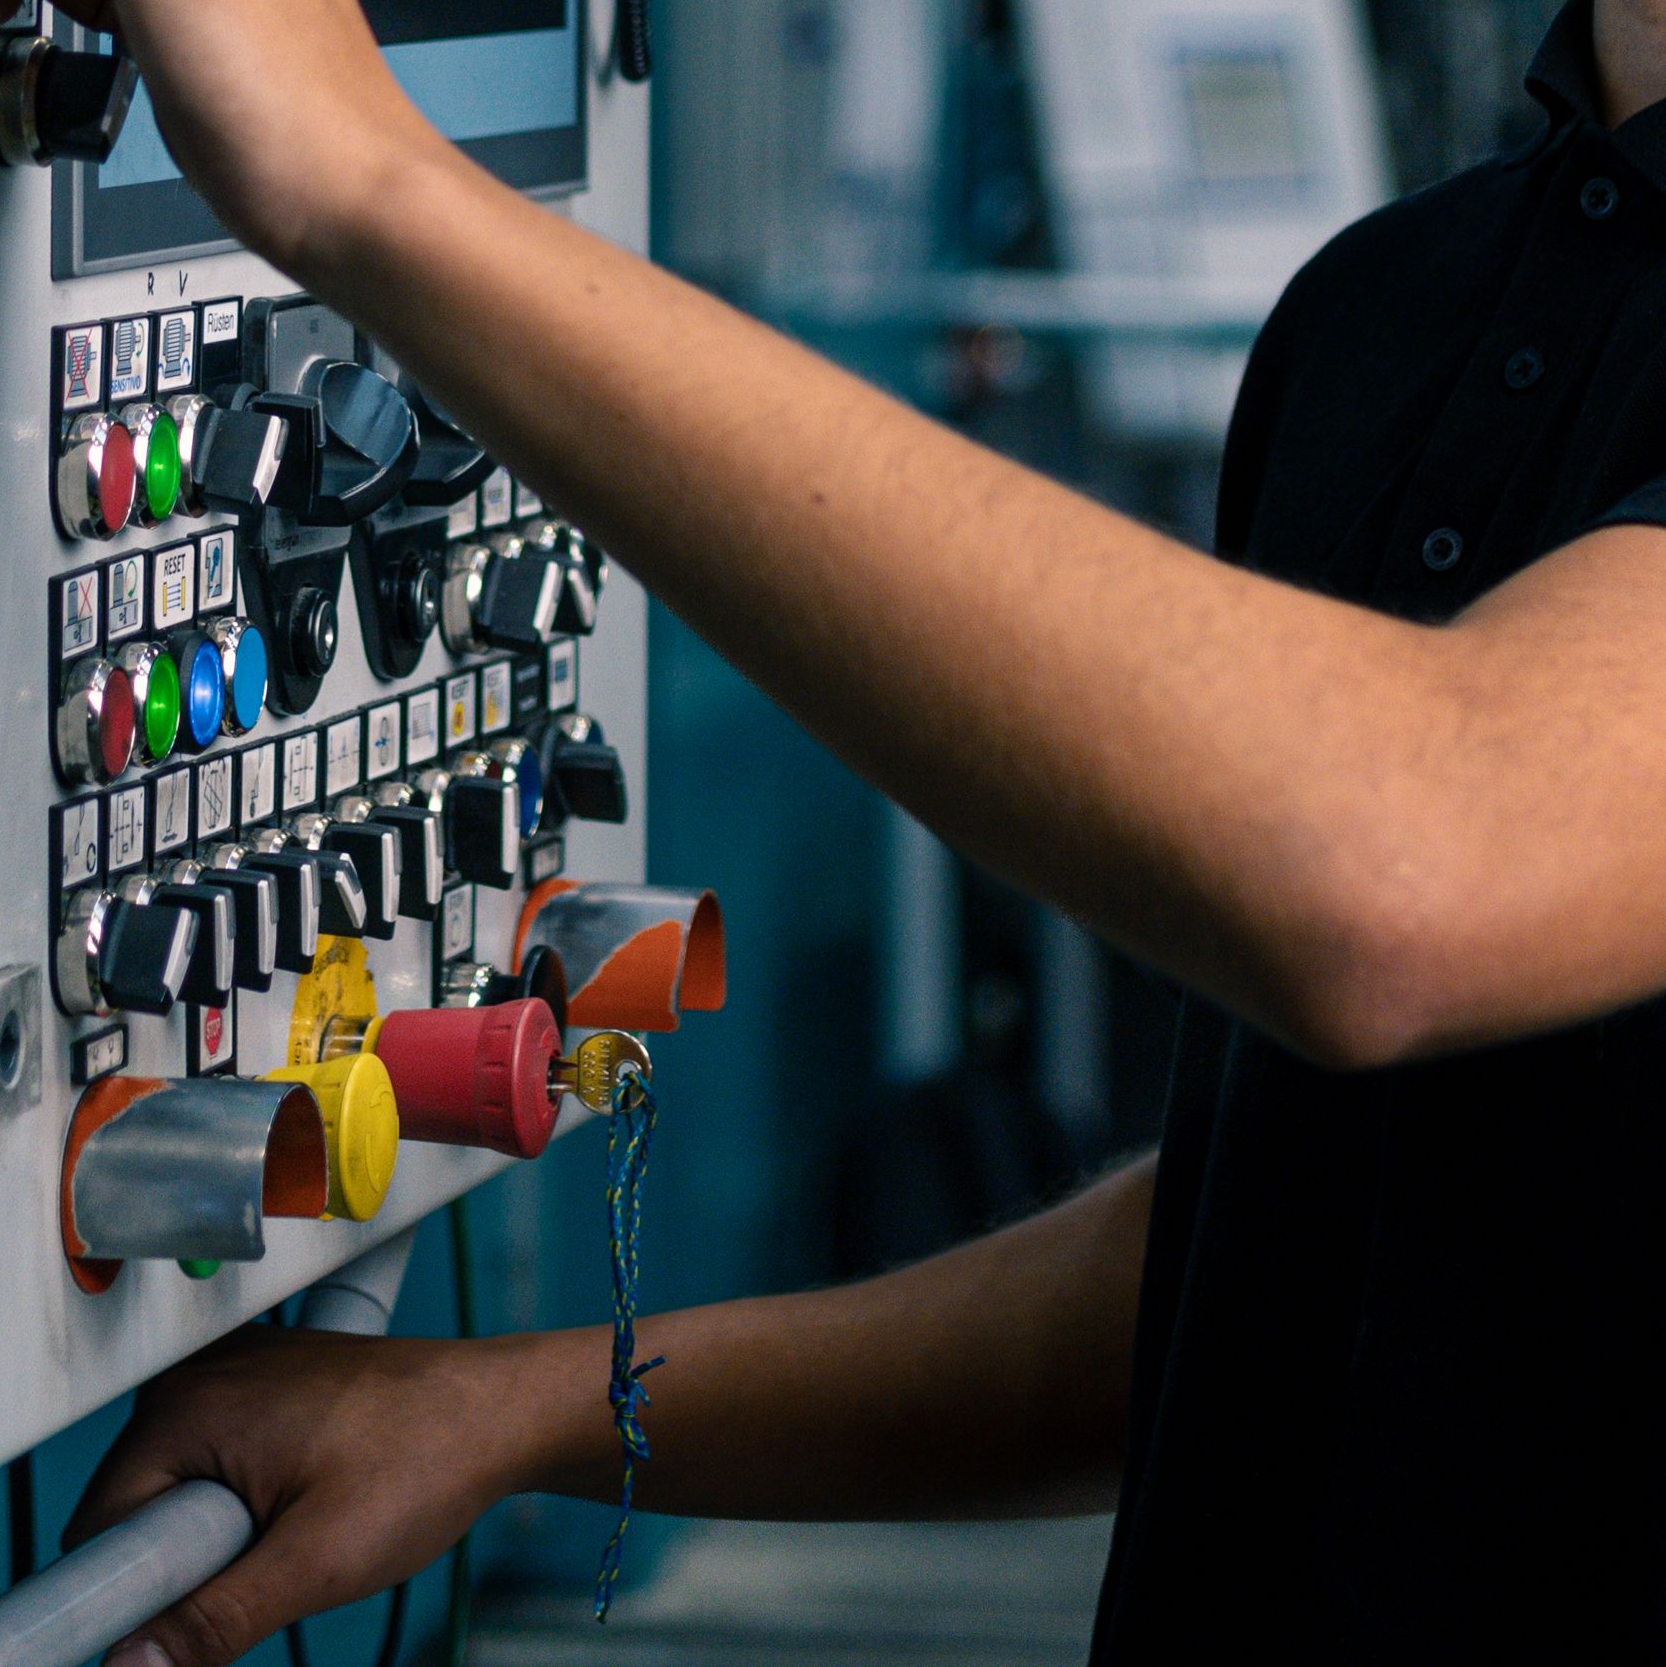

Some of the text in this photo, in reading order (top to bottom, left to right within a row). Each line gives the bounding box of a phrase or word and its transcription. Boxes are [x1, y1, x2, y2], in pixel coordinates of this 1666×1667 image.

[147, 271, 155, 295] R
[179, 270, 189, 297] V
[208, 313, 234, 334] Rüsten
[164, 553, 186, 577] RESET
[206, 1017, 221, 1040] STOP
